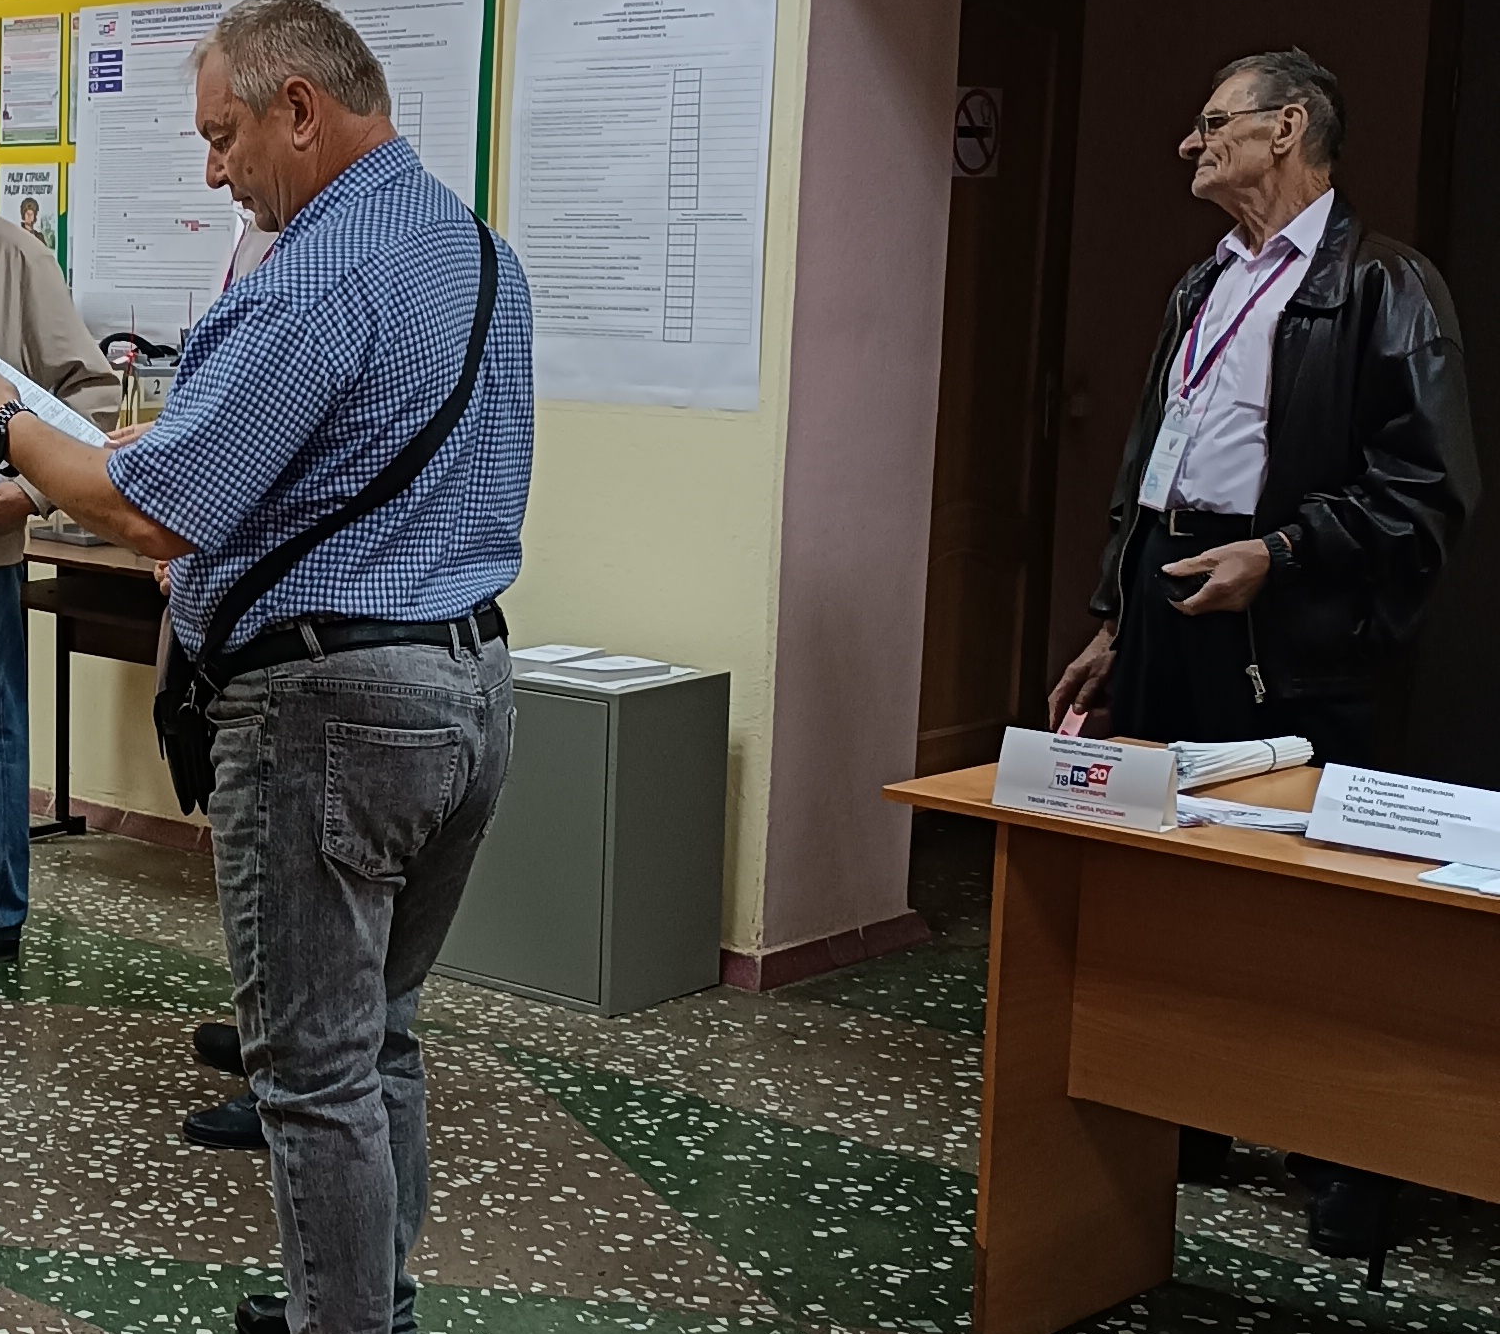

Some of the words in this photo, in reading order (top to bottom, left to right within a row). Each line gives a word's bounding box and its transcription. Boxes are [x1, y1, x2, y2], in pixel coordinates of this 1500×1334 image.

[153, 379, 161, 395] 2
[1055, 774, 1068, 786] 18
[1072, 770, 1086, 783] 19
[1089, 768, 1107, 780] 20
